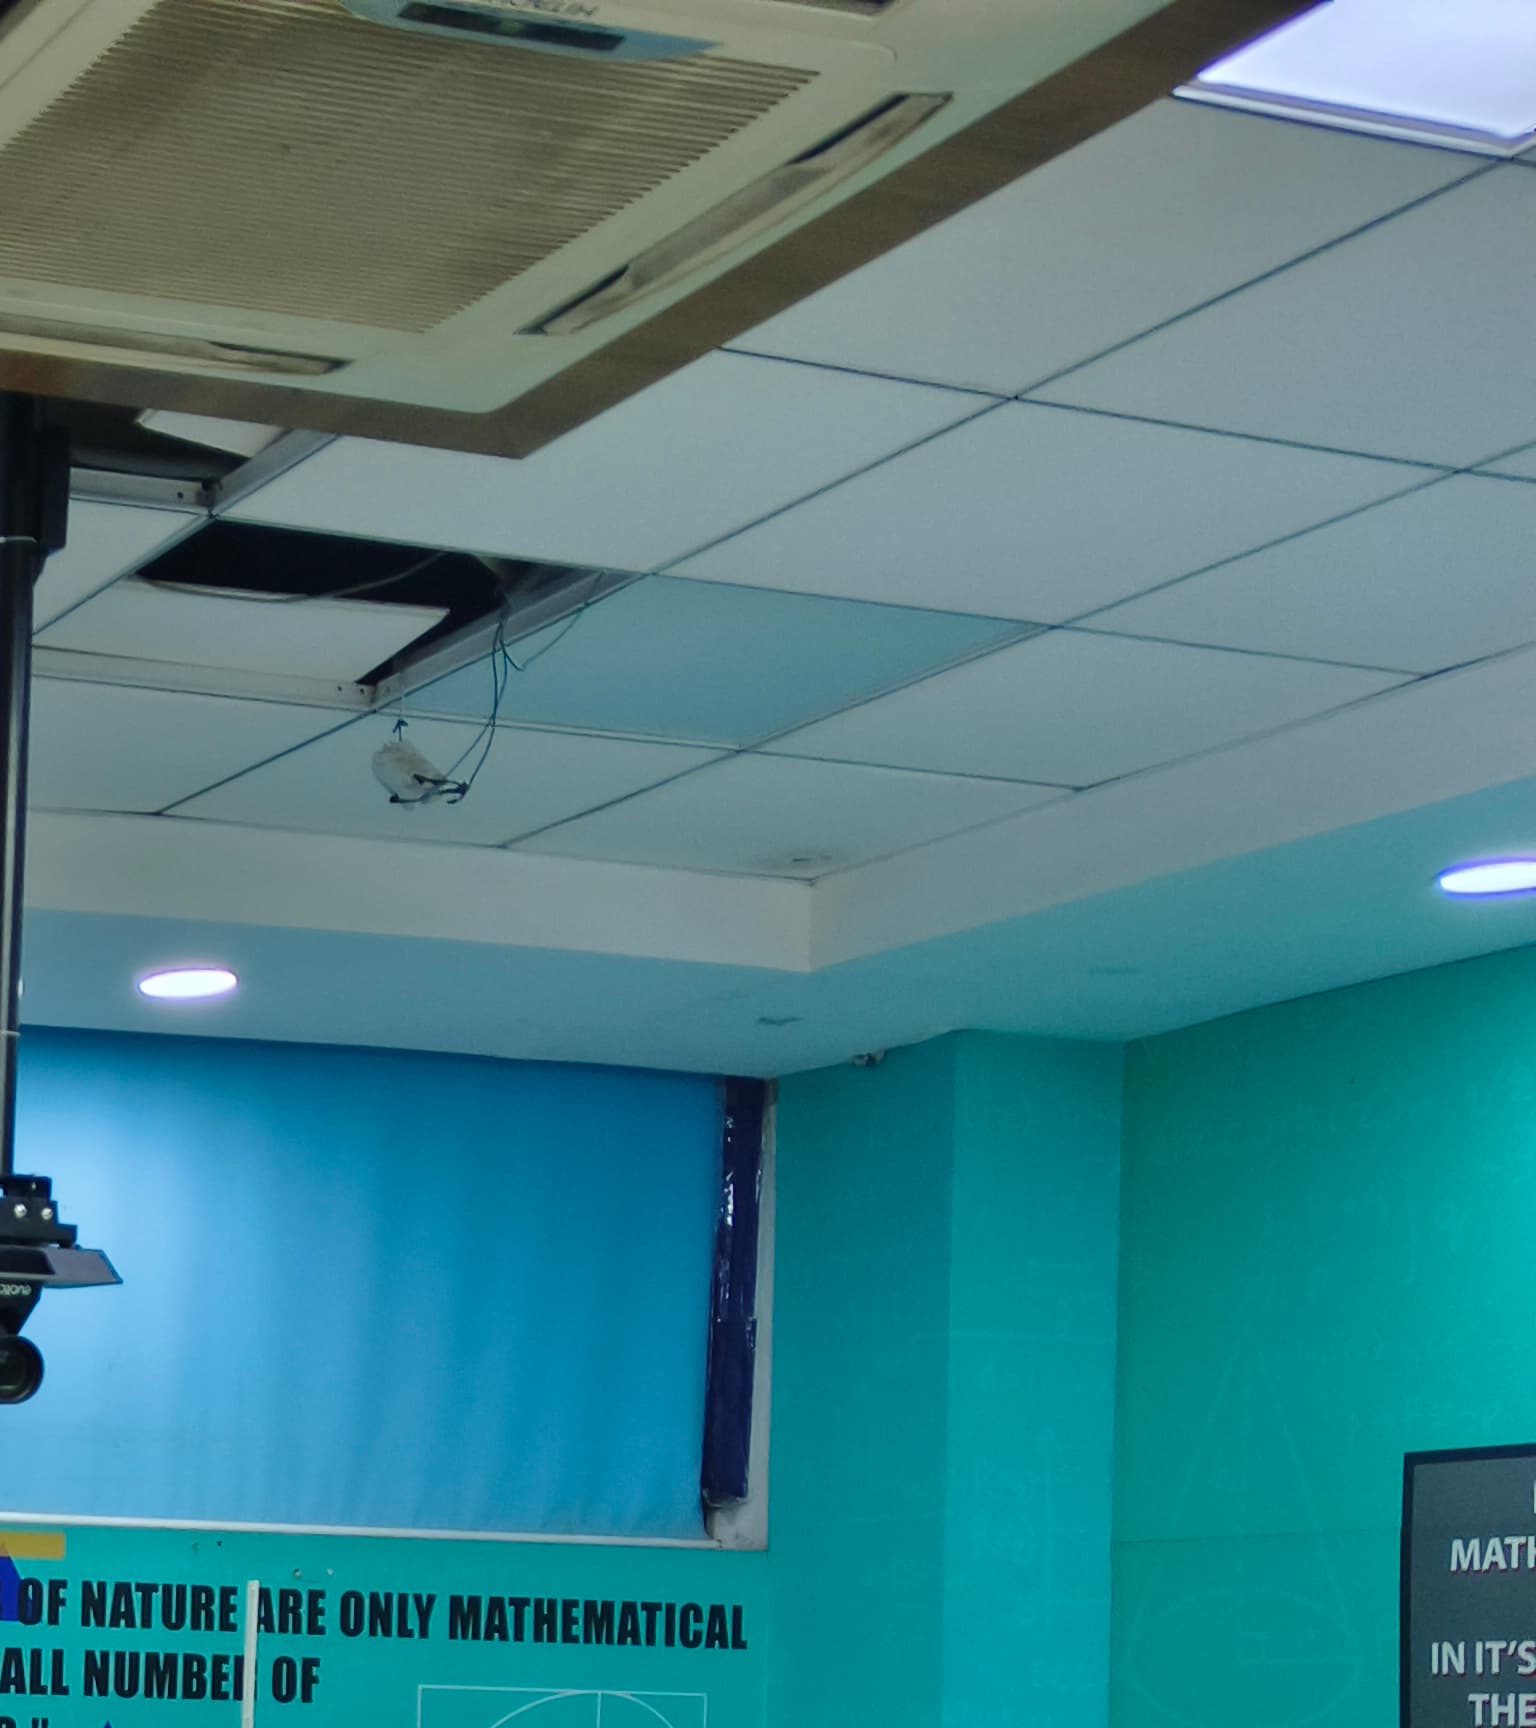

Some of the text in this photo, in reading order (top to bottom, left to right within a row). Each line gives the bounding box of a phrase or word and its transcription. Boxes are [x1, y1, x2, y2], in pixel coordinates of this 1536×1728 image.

[17, 1578, 68, 1626] OF
[81, 1580, 239, 1632] NATURE
[256, 1587, 327, 1636] ARE
[339, 1590, 438, 1639] ONLY
[448, 1594, 748, 1650] MATHEMATICAL
[272, 1656, 321, 1703] OF
[1431, 1641, 1465, 1675] IN
